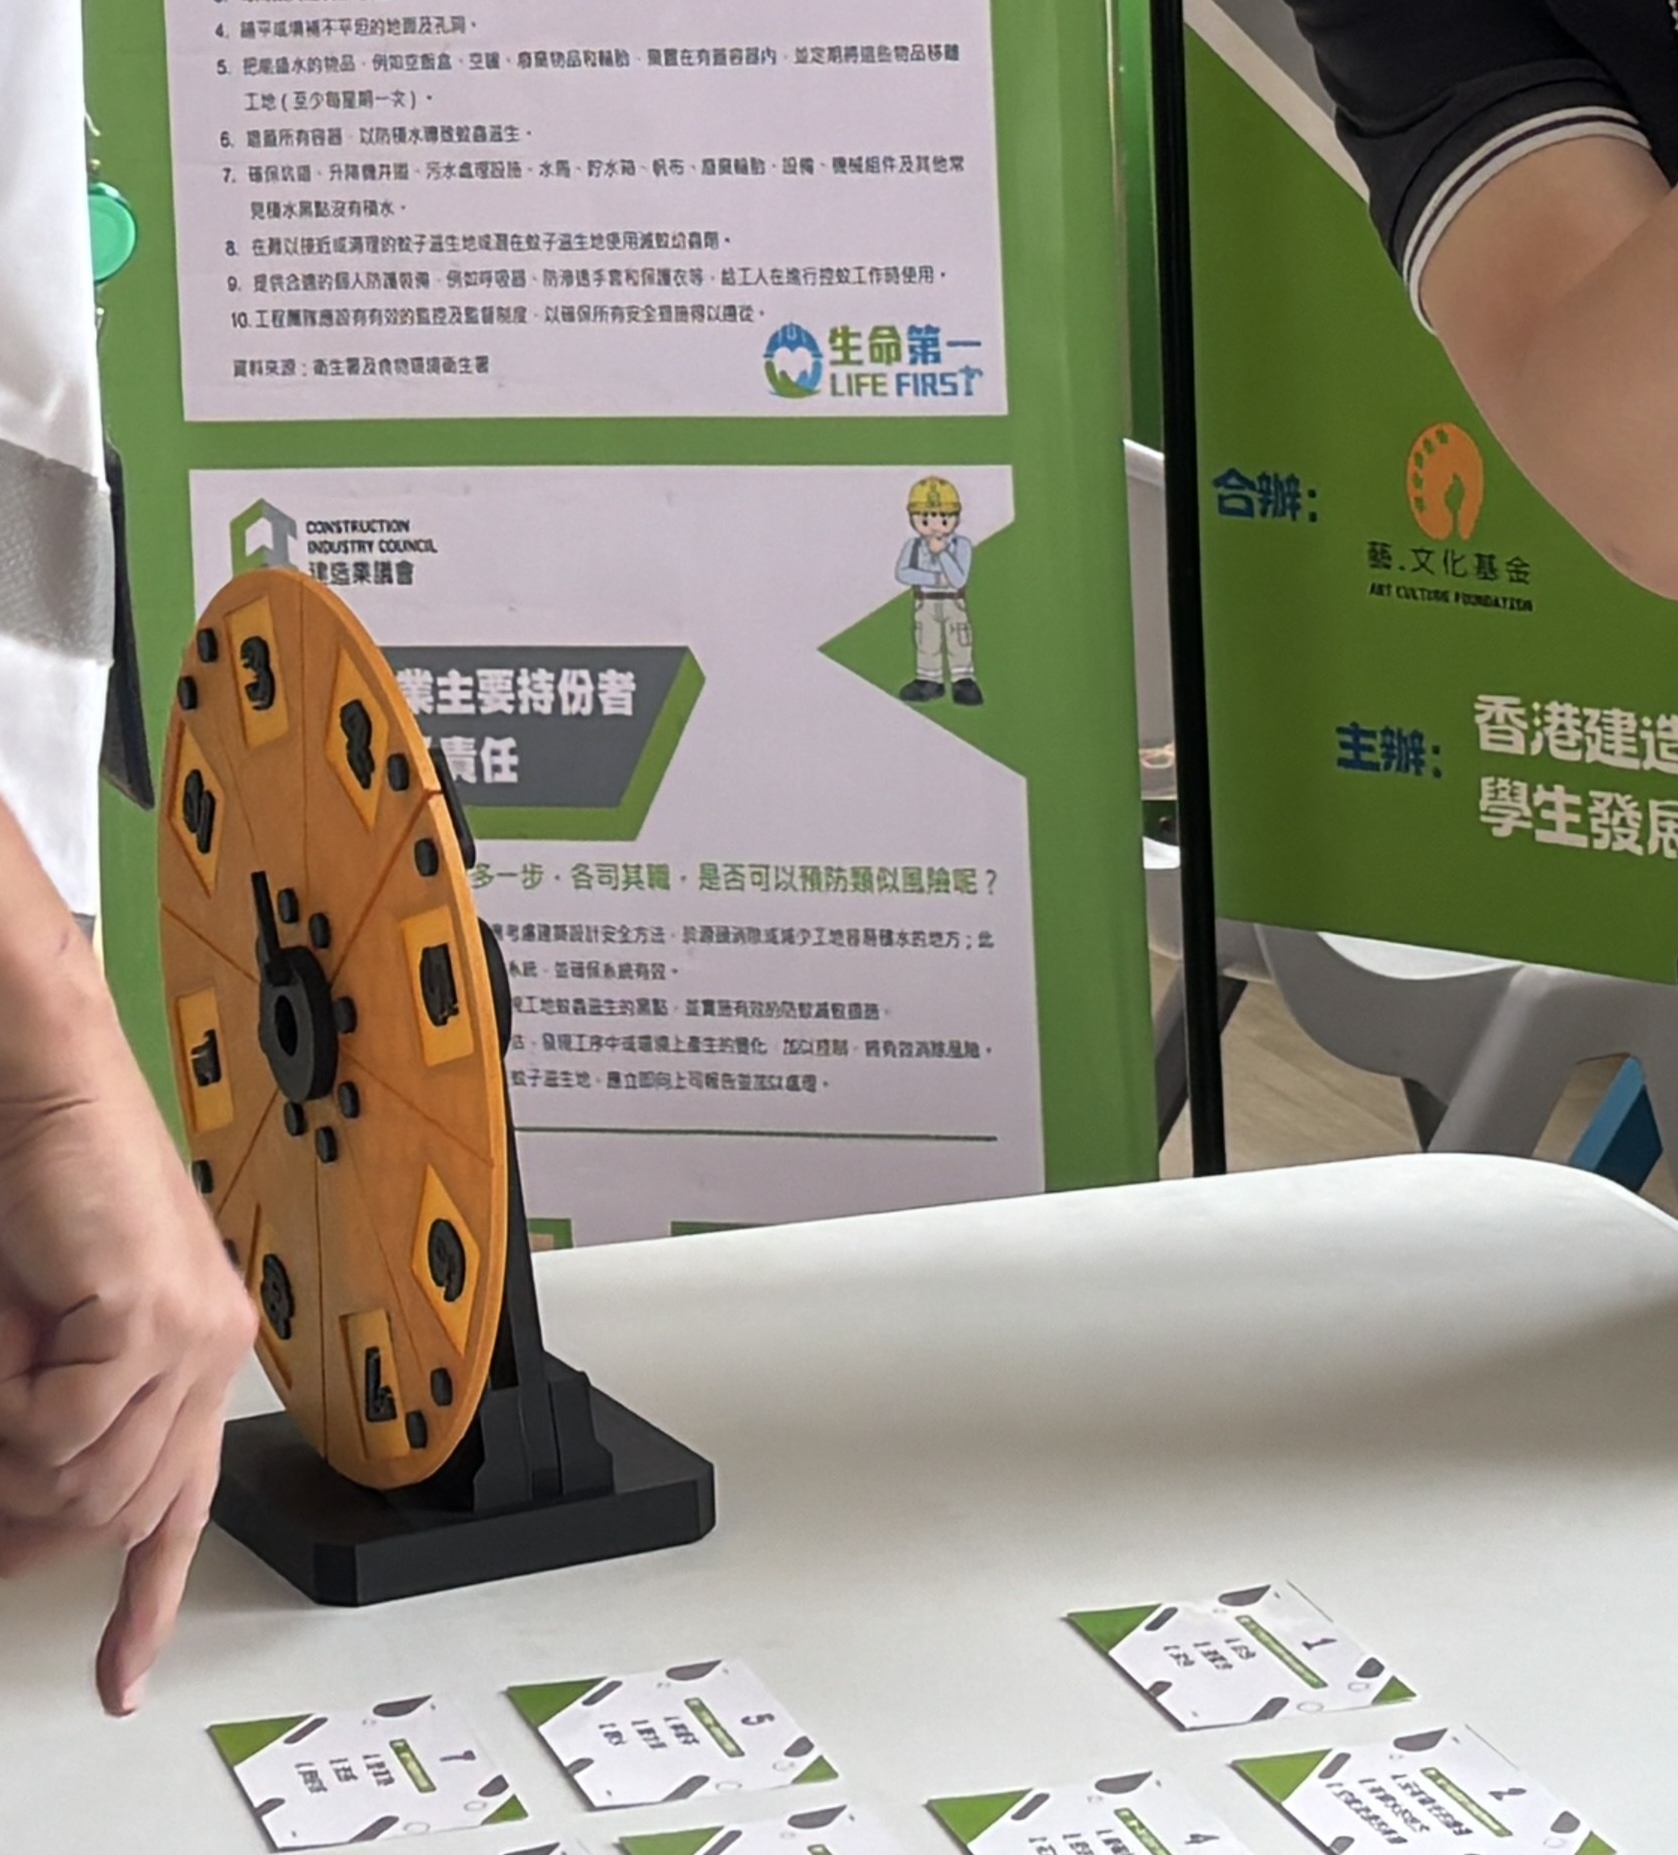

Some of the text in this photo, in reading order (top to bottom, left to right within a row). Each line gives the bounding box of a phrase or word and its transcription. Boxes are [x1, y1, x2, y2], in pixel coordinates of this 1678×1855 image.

[828, 323, 982, 366] 生命第一
[829, 365, 984, 397] LIFE FIRST
[306, 518, 410, 535] CONSTRUCTION
[307, 538, 438, 555] INDUSTRY COUNCIL
[308, 560, 414, 586] 建造業議會
[1368, 581, 1534, 613] ART CULTURE FOUNDATION
[397, 668, 636, 716] 業主要持份者
[424, 736, 519, 784] 責任
[1334, 720, 1444, 779] 主辦:
